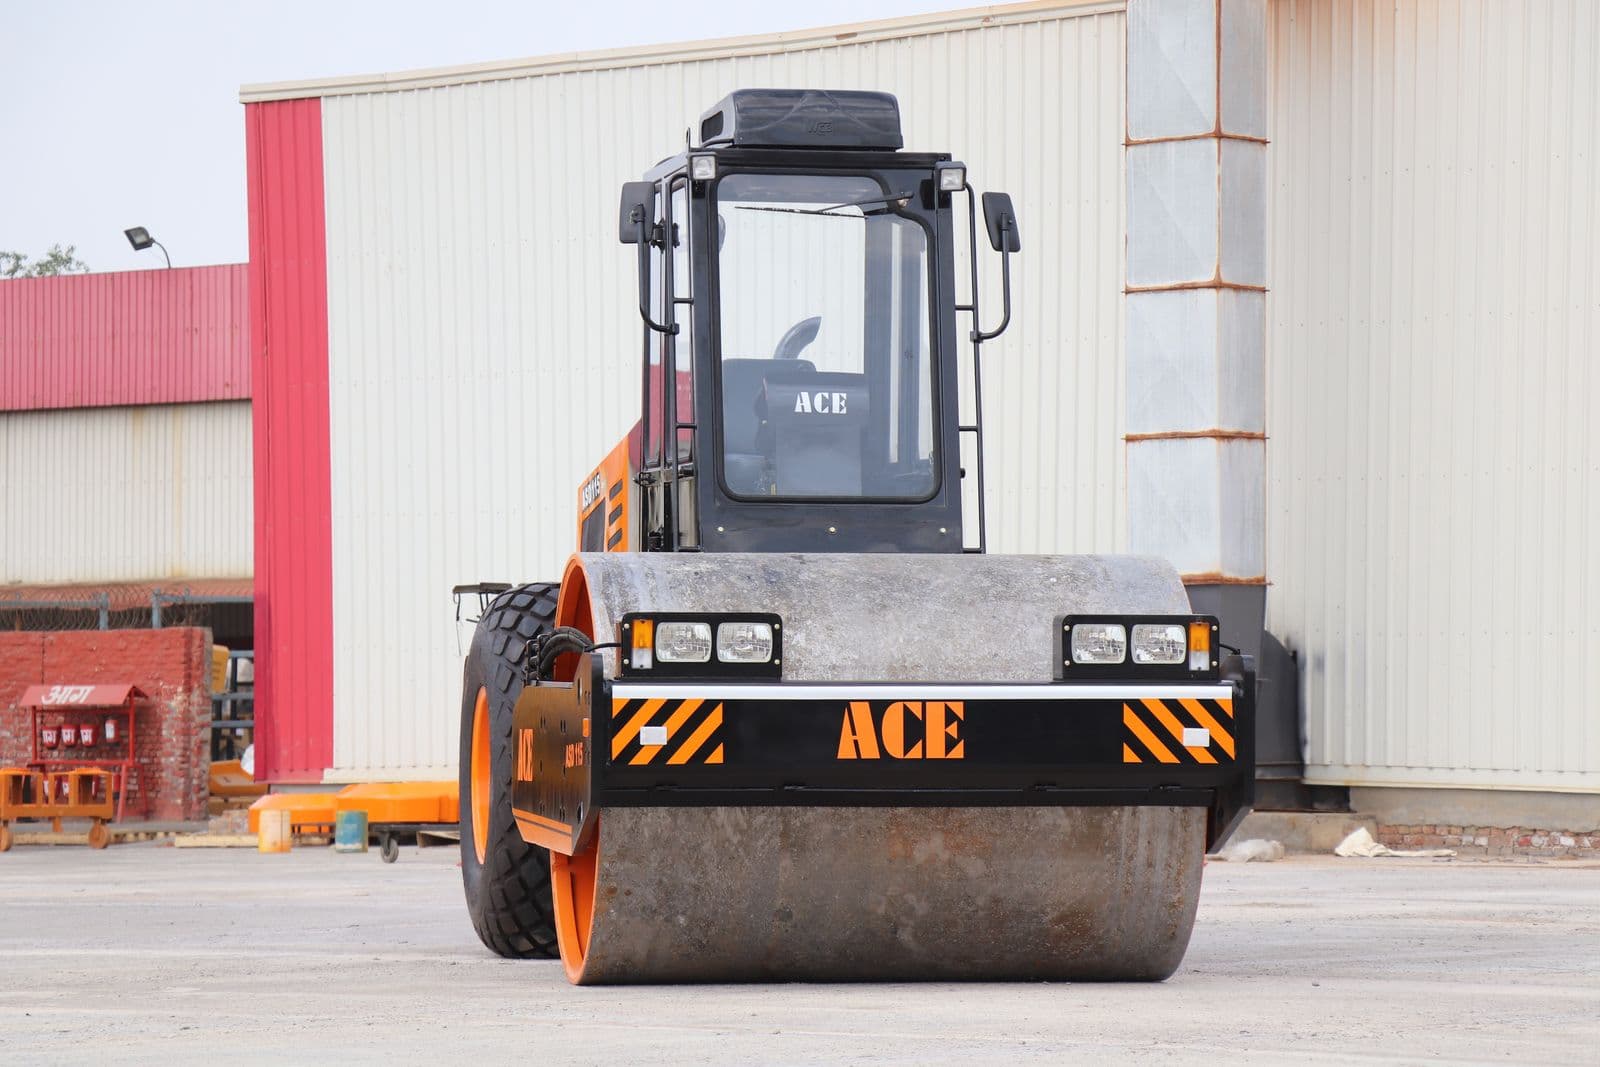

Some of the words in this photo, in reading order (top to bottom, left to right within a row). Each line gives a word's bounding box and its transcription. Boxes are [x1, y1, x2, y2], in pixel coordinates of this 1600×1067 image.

[795, 391, 847, 414] ACE
[41, 685, 96, 705] आग
[837, 701, 964, 759] ACE
[517, 728, 534, 781] ACE
